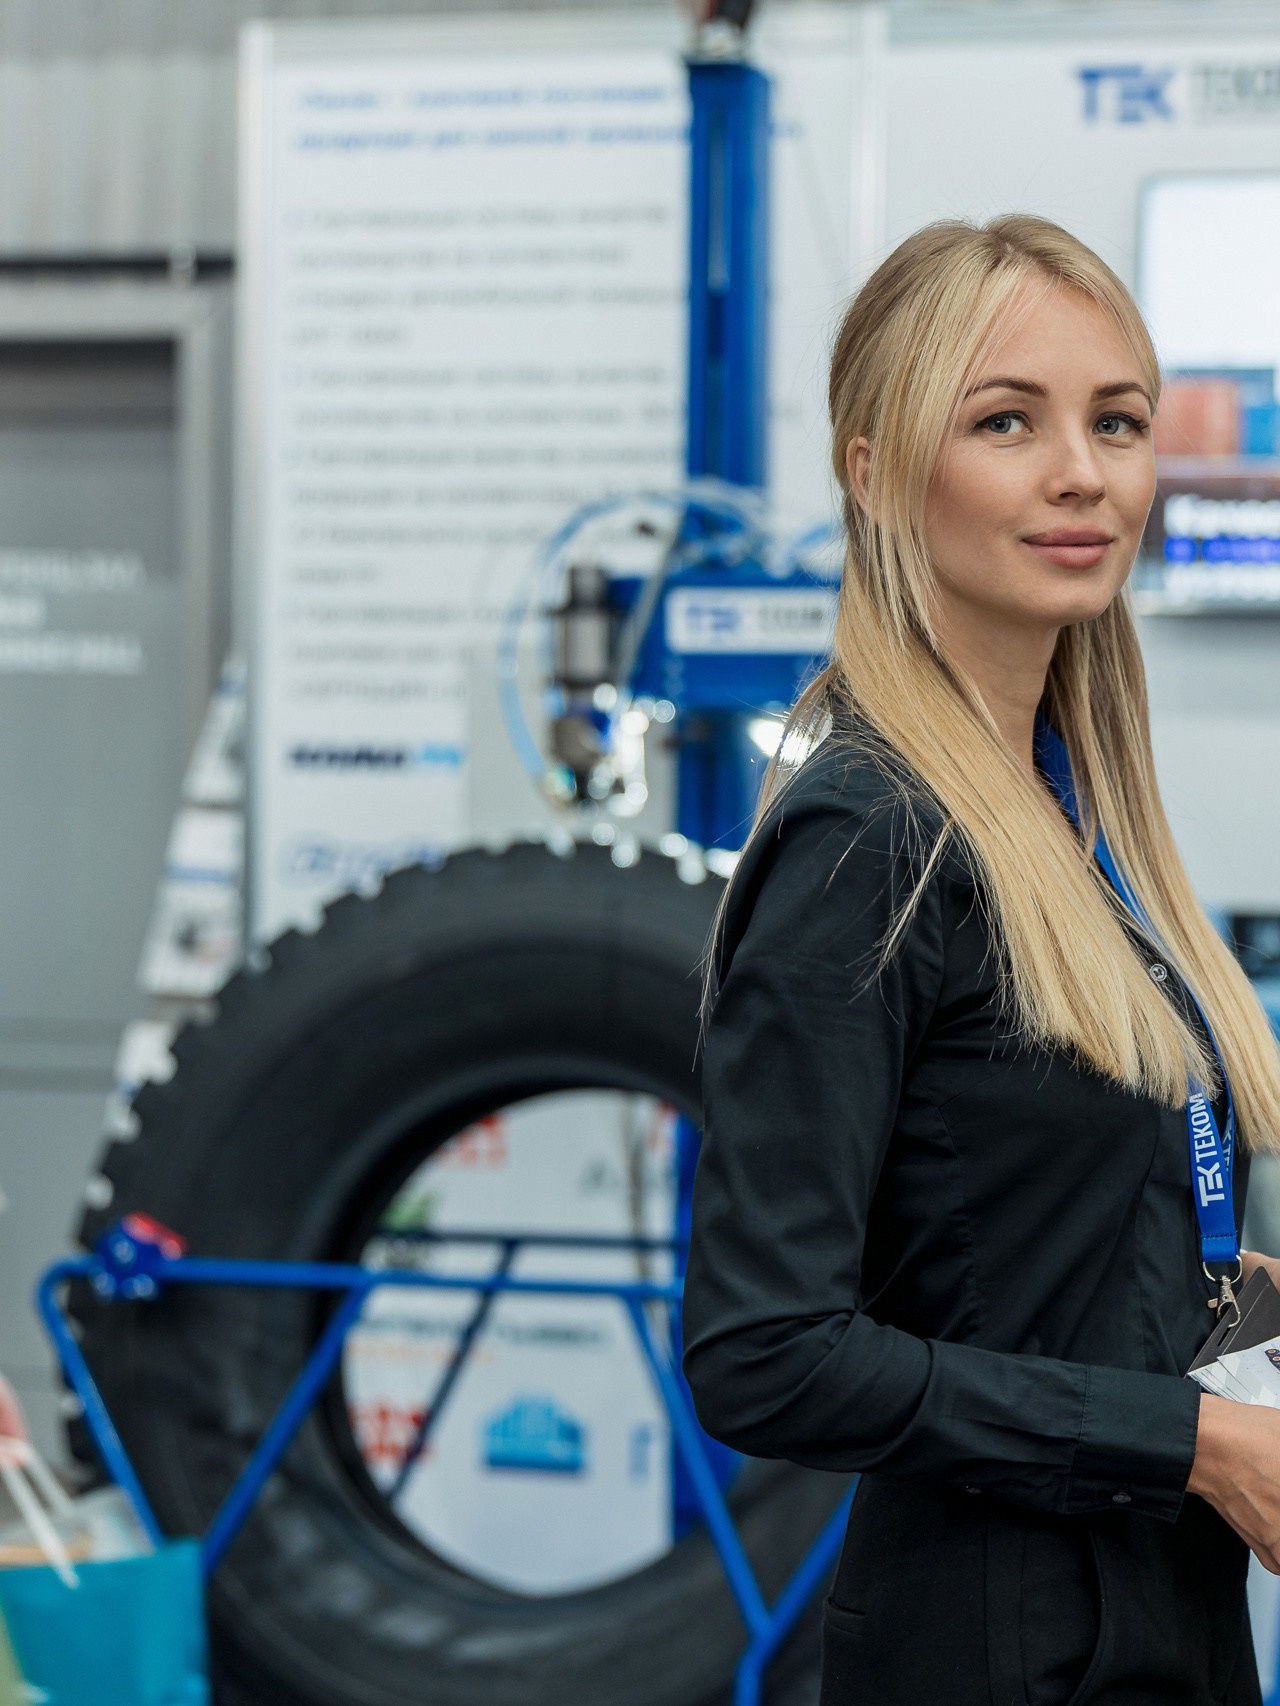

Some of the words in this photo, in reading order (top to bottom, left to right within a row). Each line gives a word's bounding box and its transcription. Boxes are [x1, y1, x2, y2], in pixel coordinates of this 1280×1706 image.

[1078, 64, 1175, 123] TEK
[1189, 1092, 1218, 1163] TEKOM
[1197, 1161, 1225, 1207] TEK
